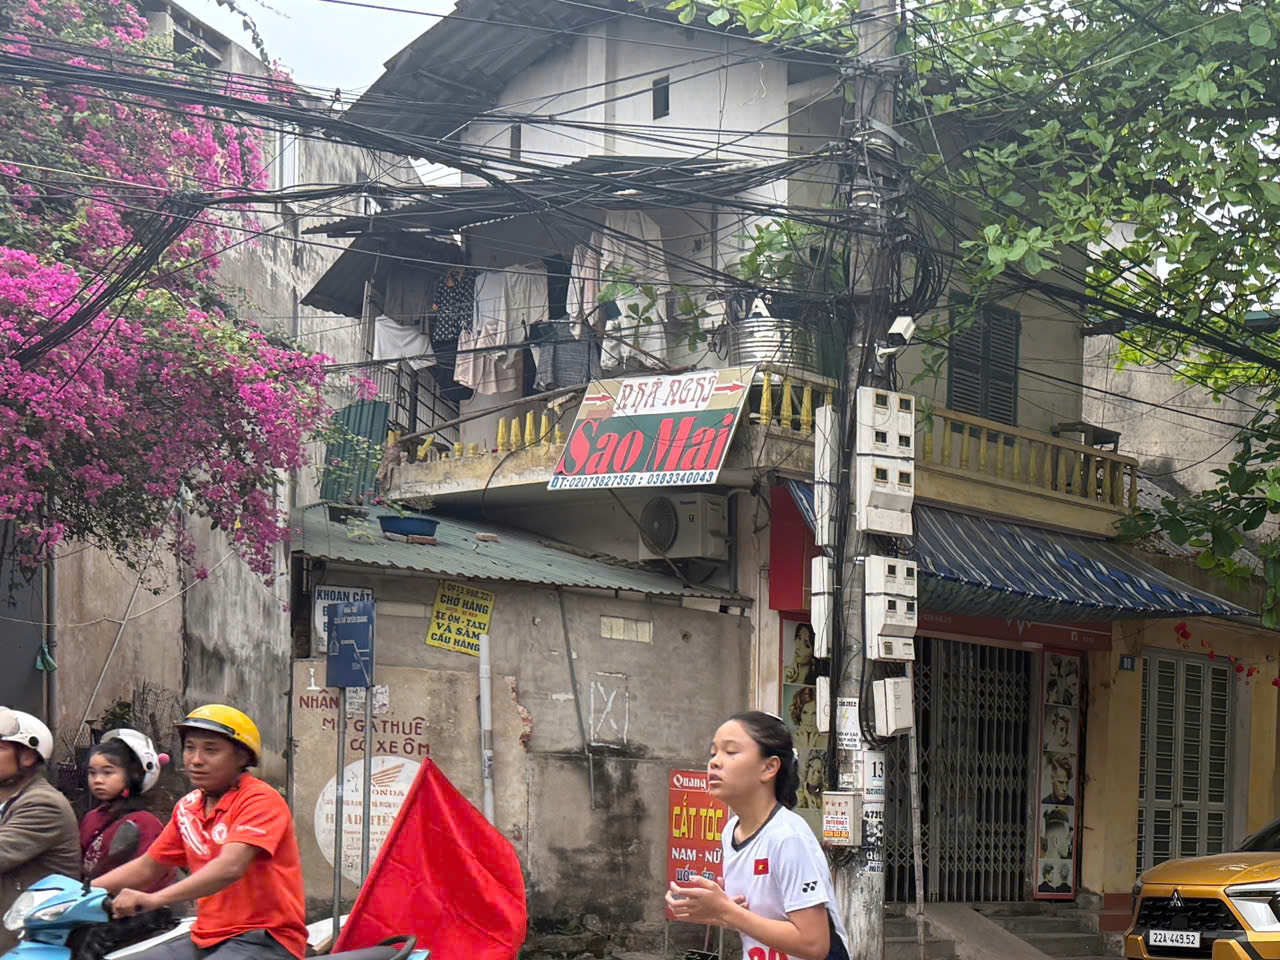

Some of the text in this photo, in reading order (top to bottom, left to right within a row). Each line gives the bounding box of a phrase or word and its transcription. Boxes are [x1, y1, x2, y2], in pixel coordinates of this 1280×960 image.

[555, 413, 734, 476] Sao Mai
[647, 471, 713, 485] 0383340043
[316, 589, 350, 601] KHOAN
[466, 618, 487, 631] TAXI
[381, 716, 426, 735] THUÊ
[376, 740, 398, 754] XE
[403, 737, 430, 755] ÔM
[673, 774, 707, 791] Quang
[700, 800, 723, 841] TÓC
[671, 847, 696, 860] NAM
